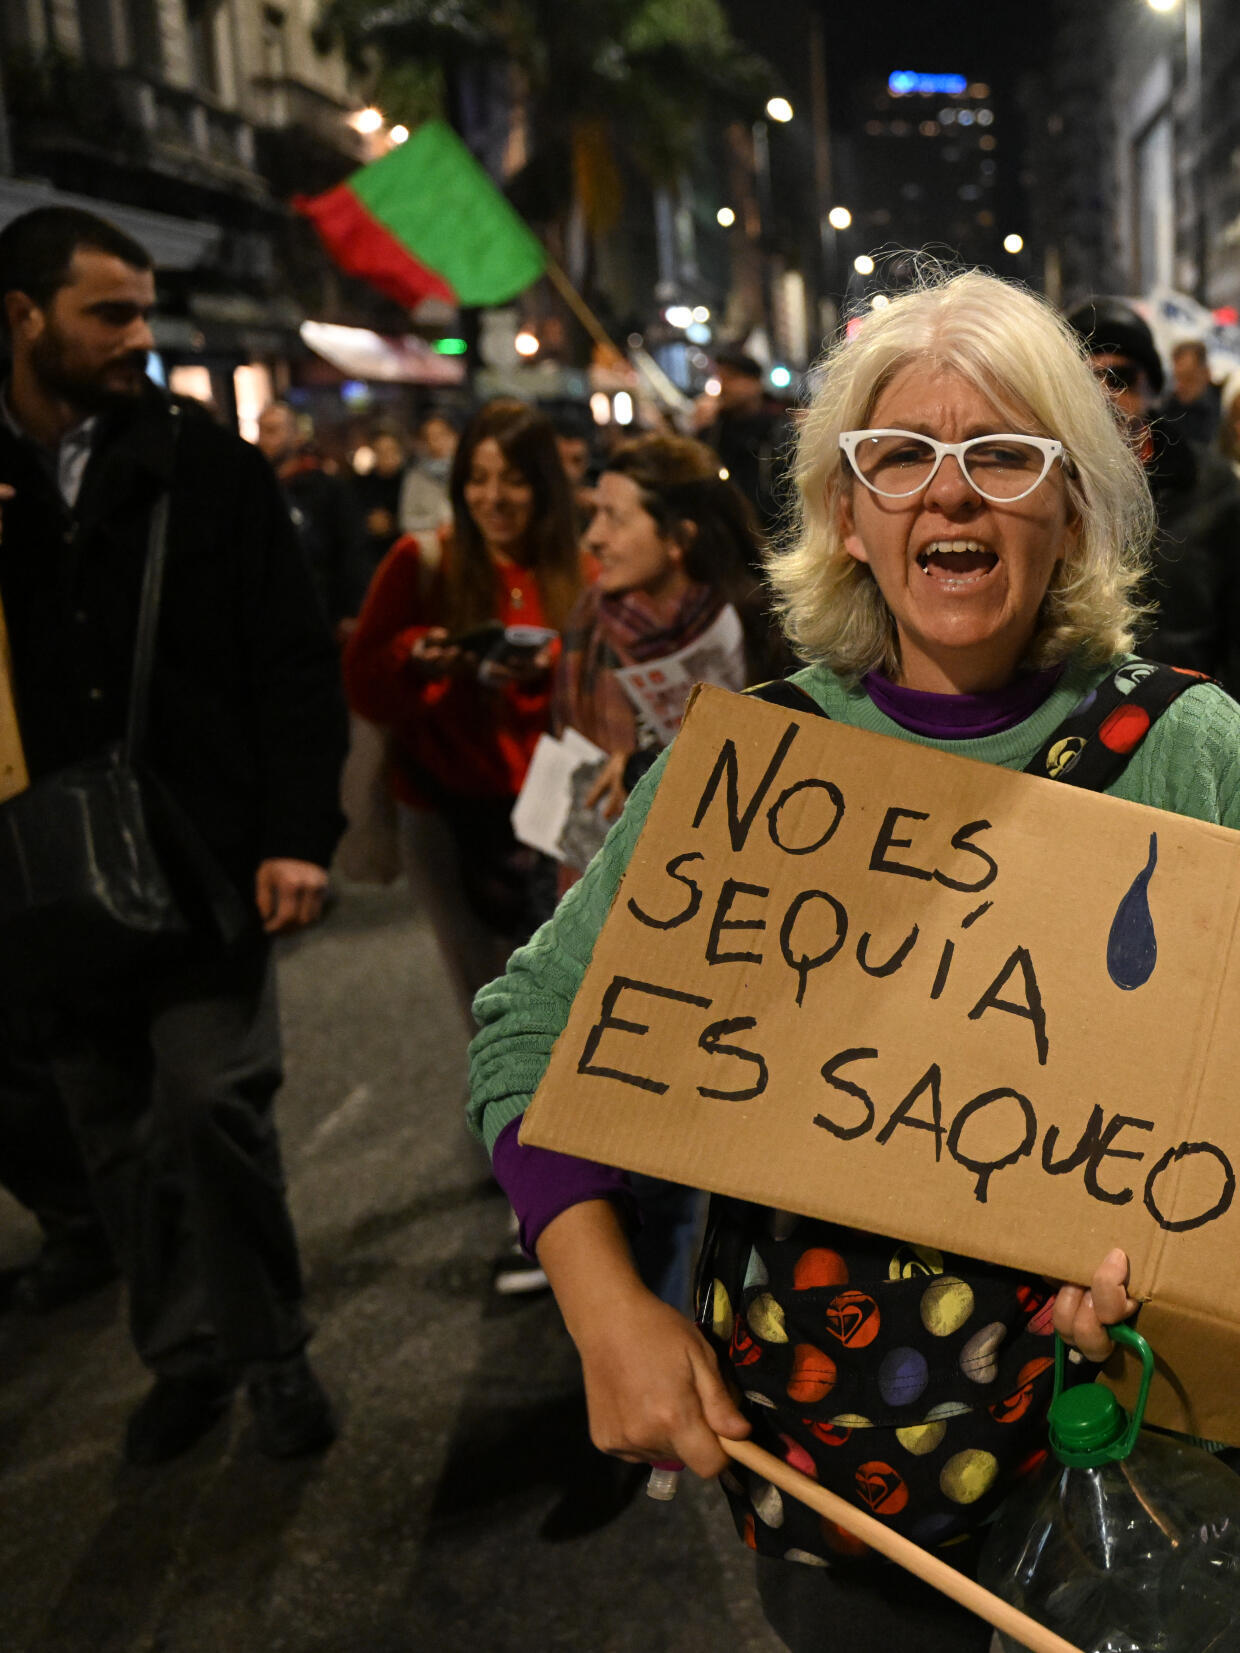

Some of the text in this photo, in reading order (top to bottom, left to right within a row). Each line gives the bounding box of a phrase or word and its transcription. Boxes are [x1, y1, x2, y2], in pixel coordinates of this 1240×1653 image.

[692, 723, 1000, 893] NO ES
[577, 976, 769, 1102] ES
[627, 851, 1049, 1066] SEQUÍA
